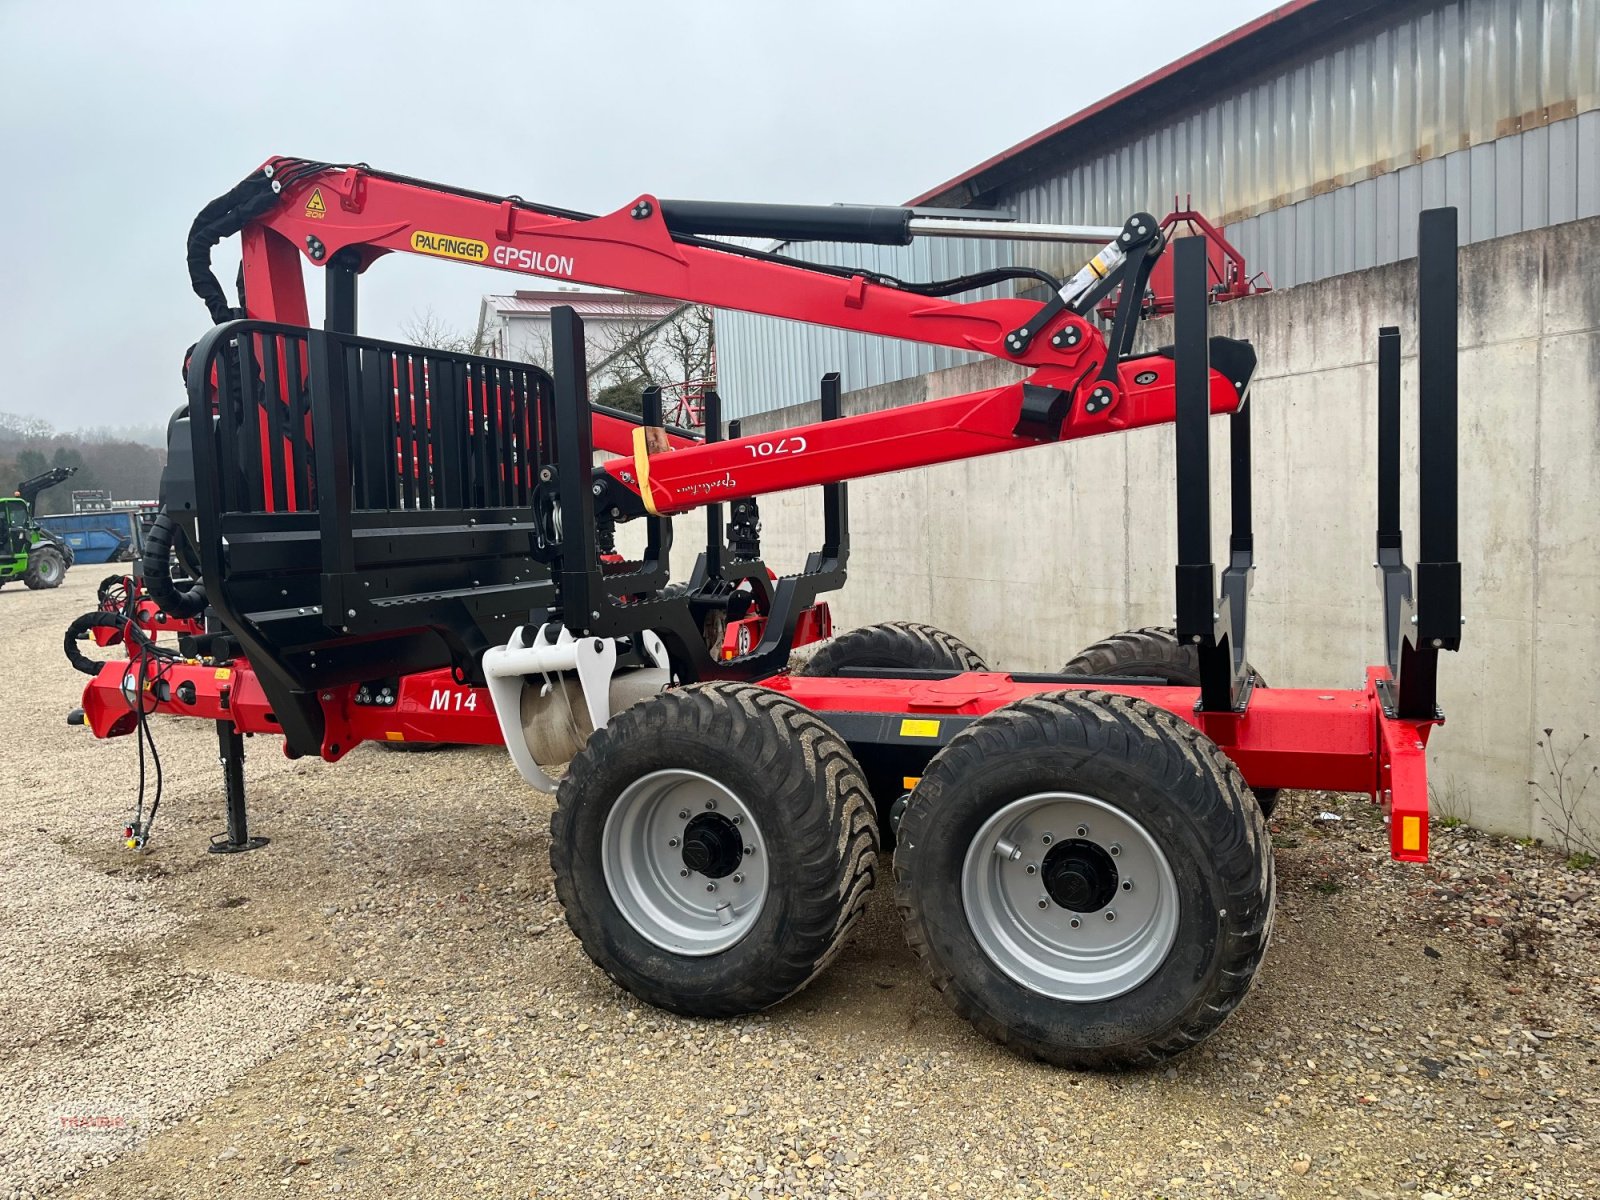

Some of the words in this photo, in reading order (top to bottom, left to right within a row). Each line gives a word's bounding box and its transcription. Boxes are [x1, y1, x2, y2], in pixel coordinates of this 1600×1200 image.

[415, 234, 484, 258] PALFINGER
[493, 245, 574, 276] EPSILON
[744, 436, 807, 458] C70L
